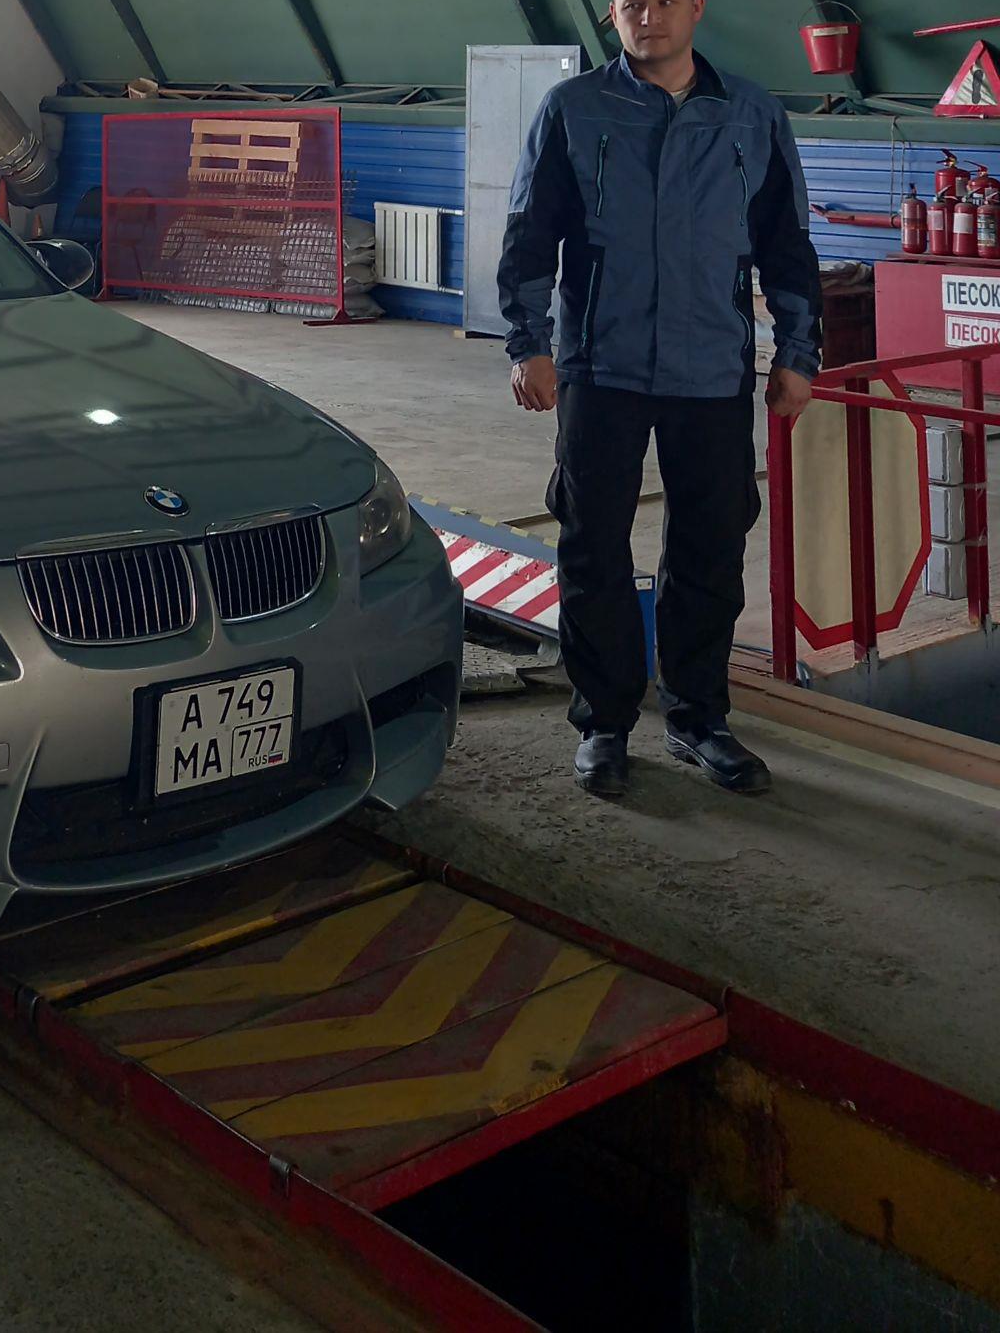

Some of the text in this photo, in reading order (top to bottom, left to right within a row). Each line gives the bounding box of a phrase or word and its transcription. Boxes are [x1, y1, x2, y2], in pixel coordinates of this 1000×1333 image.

[946, 281, 1000, 308] ПЕСОК
[181, 679, 275, 733] А 749
[172, 722, 282, 784] МА 777
[248, 753, 268, 768] RUS
